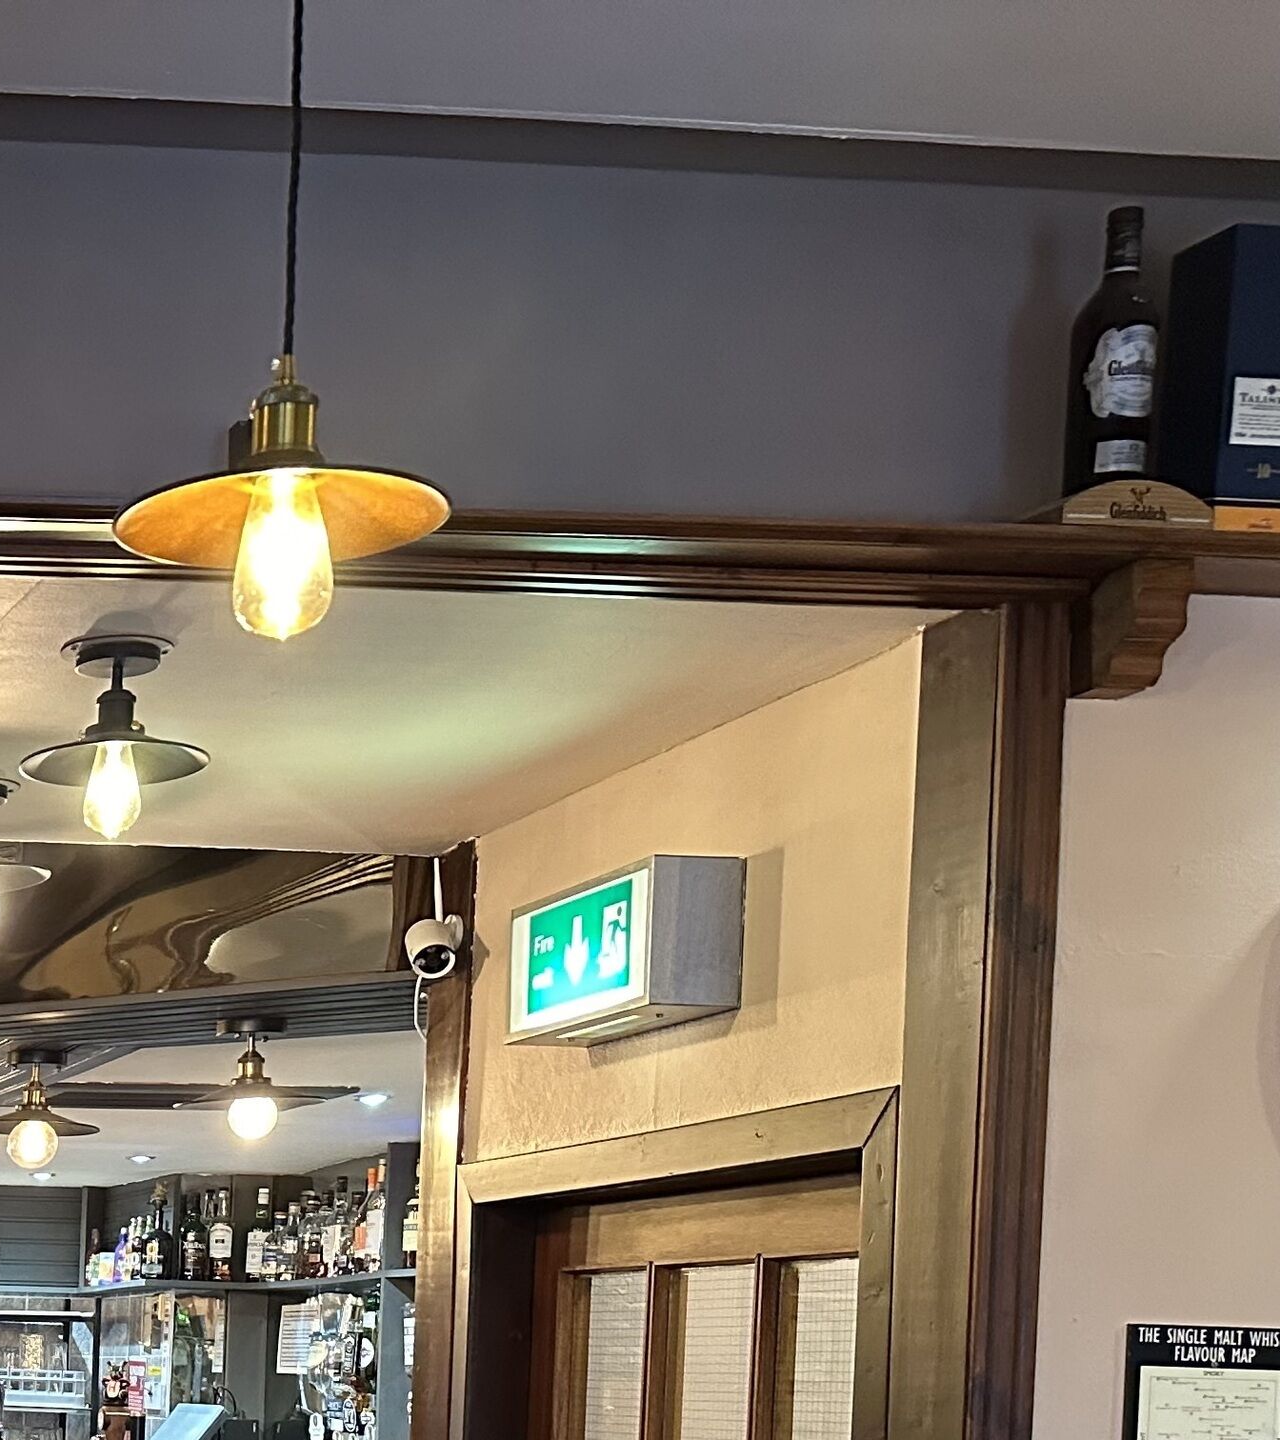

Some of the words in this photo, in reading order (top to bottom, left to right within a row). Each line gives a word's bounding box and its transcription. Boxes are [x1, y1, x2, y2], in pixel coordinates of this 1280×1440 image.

[533, 934, 555, 957] Fire
[1139, 1326, 1161, 1344] THE
[1167, 1327, 1207, 1346] SINGLE
[1214, 1329, 1243, 1347] MALT
[1249, 1331, 1280, 1348] WHIS
[1174, 1345, 1226, 1363] FLAVOUR
[1231, 1347, 1257, 1364] MAP
